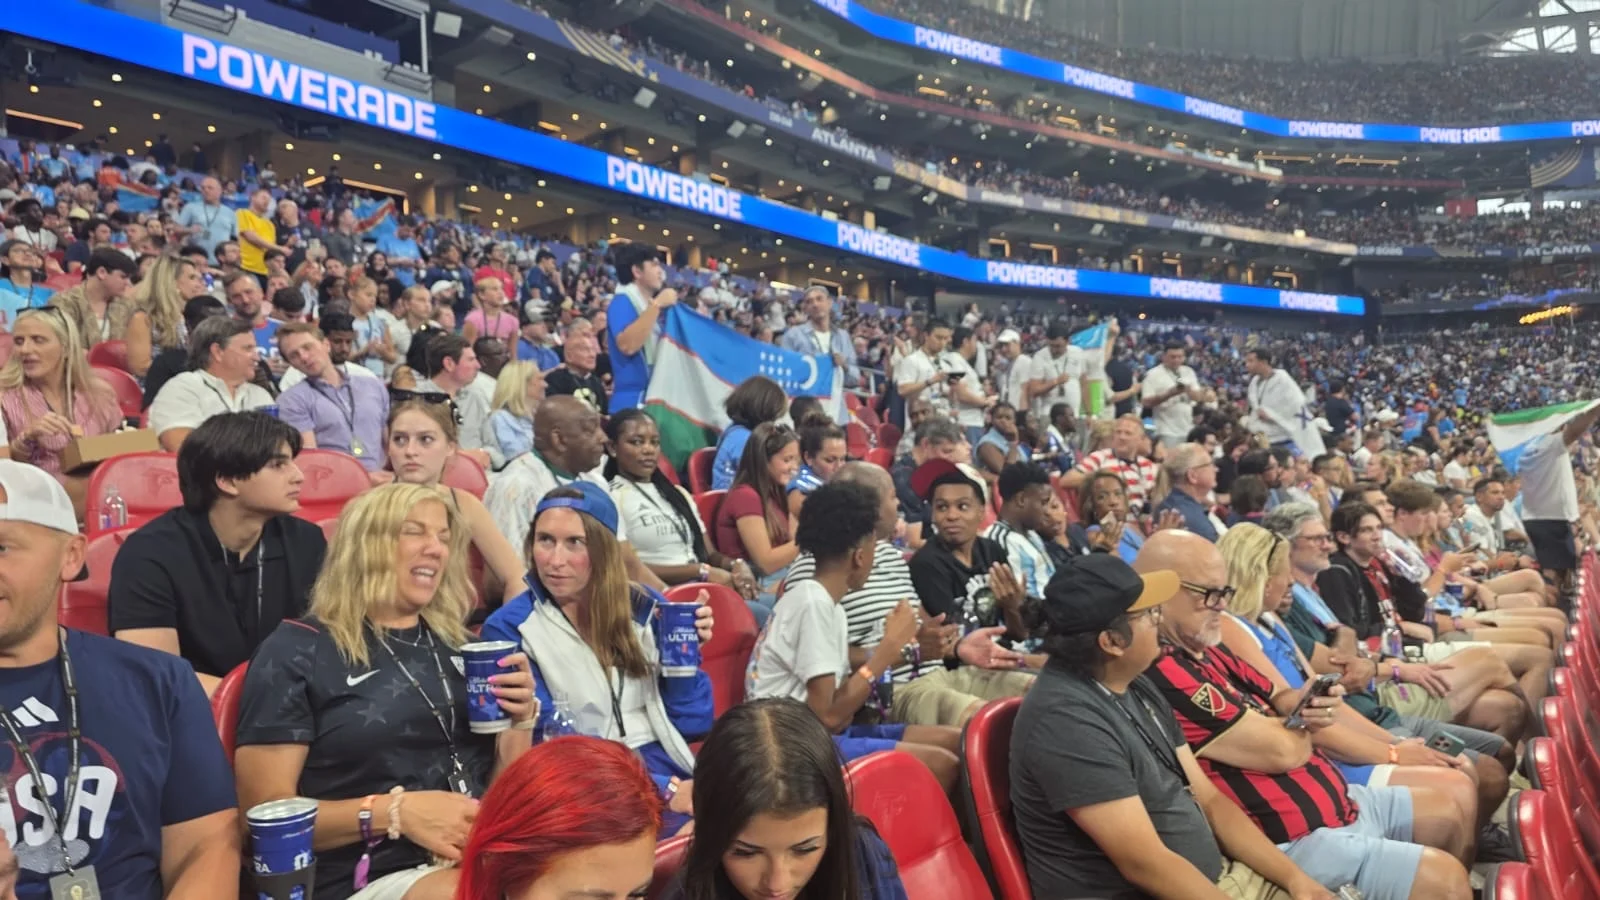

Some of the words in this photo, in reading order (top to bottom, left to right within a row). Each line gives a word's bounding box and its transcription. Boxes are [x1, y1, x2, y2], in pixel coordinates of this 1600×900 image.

[915, 26, 1003, 65] POWERADE
[182, 32, 438, 138] POWERADE
[1063, 65, 1136, 98] POWERADE
[1184, 95, 1245, 126] POWERADE
[811, 127, 877, 163] ATLANTA
[1288, 120, 1365, 139] POWERADE
[606, 154, 743, 220] POWERADE
[1172, 218, 1222, 236] ATLANTA
[837, 221, 921, 266] POWERADE
[987, 261, 1078, 290] POWERADE
[1150, 276, 1223, 302] POWERADE
[1279, 289, 1338, 313] POWERADE
